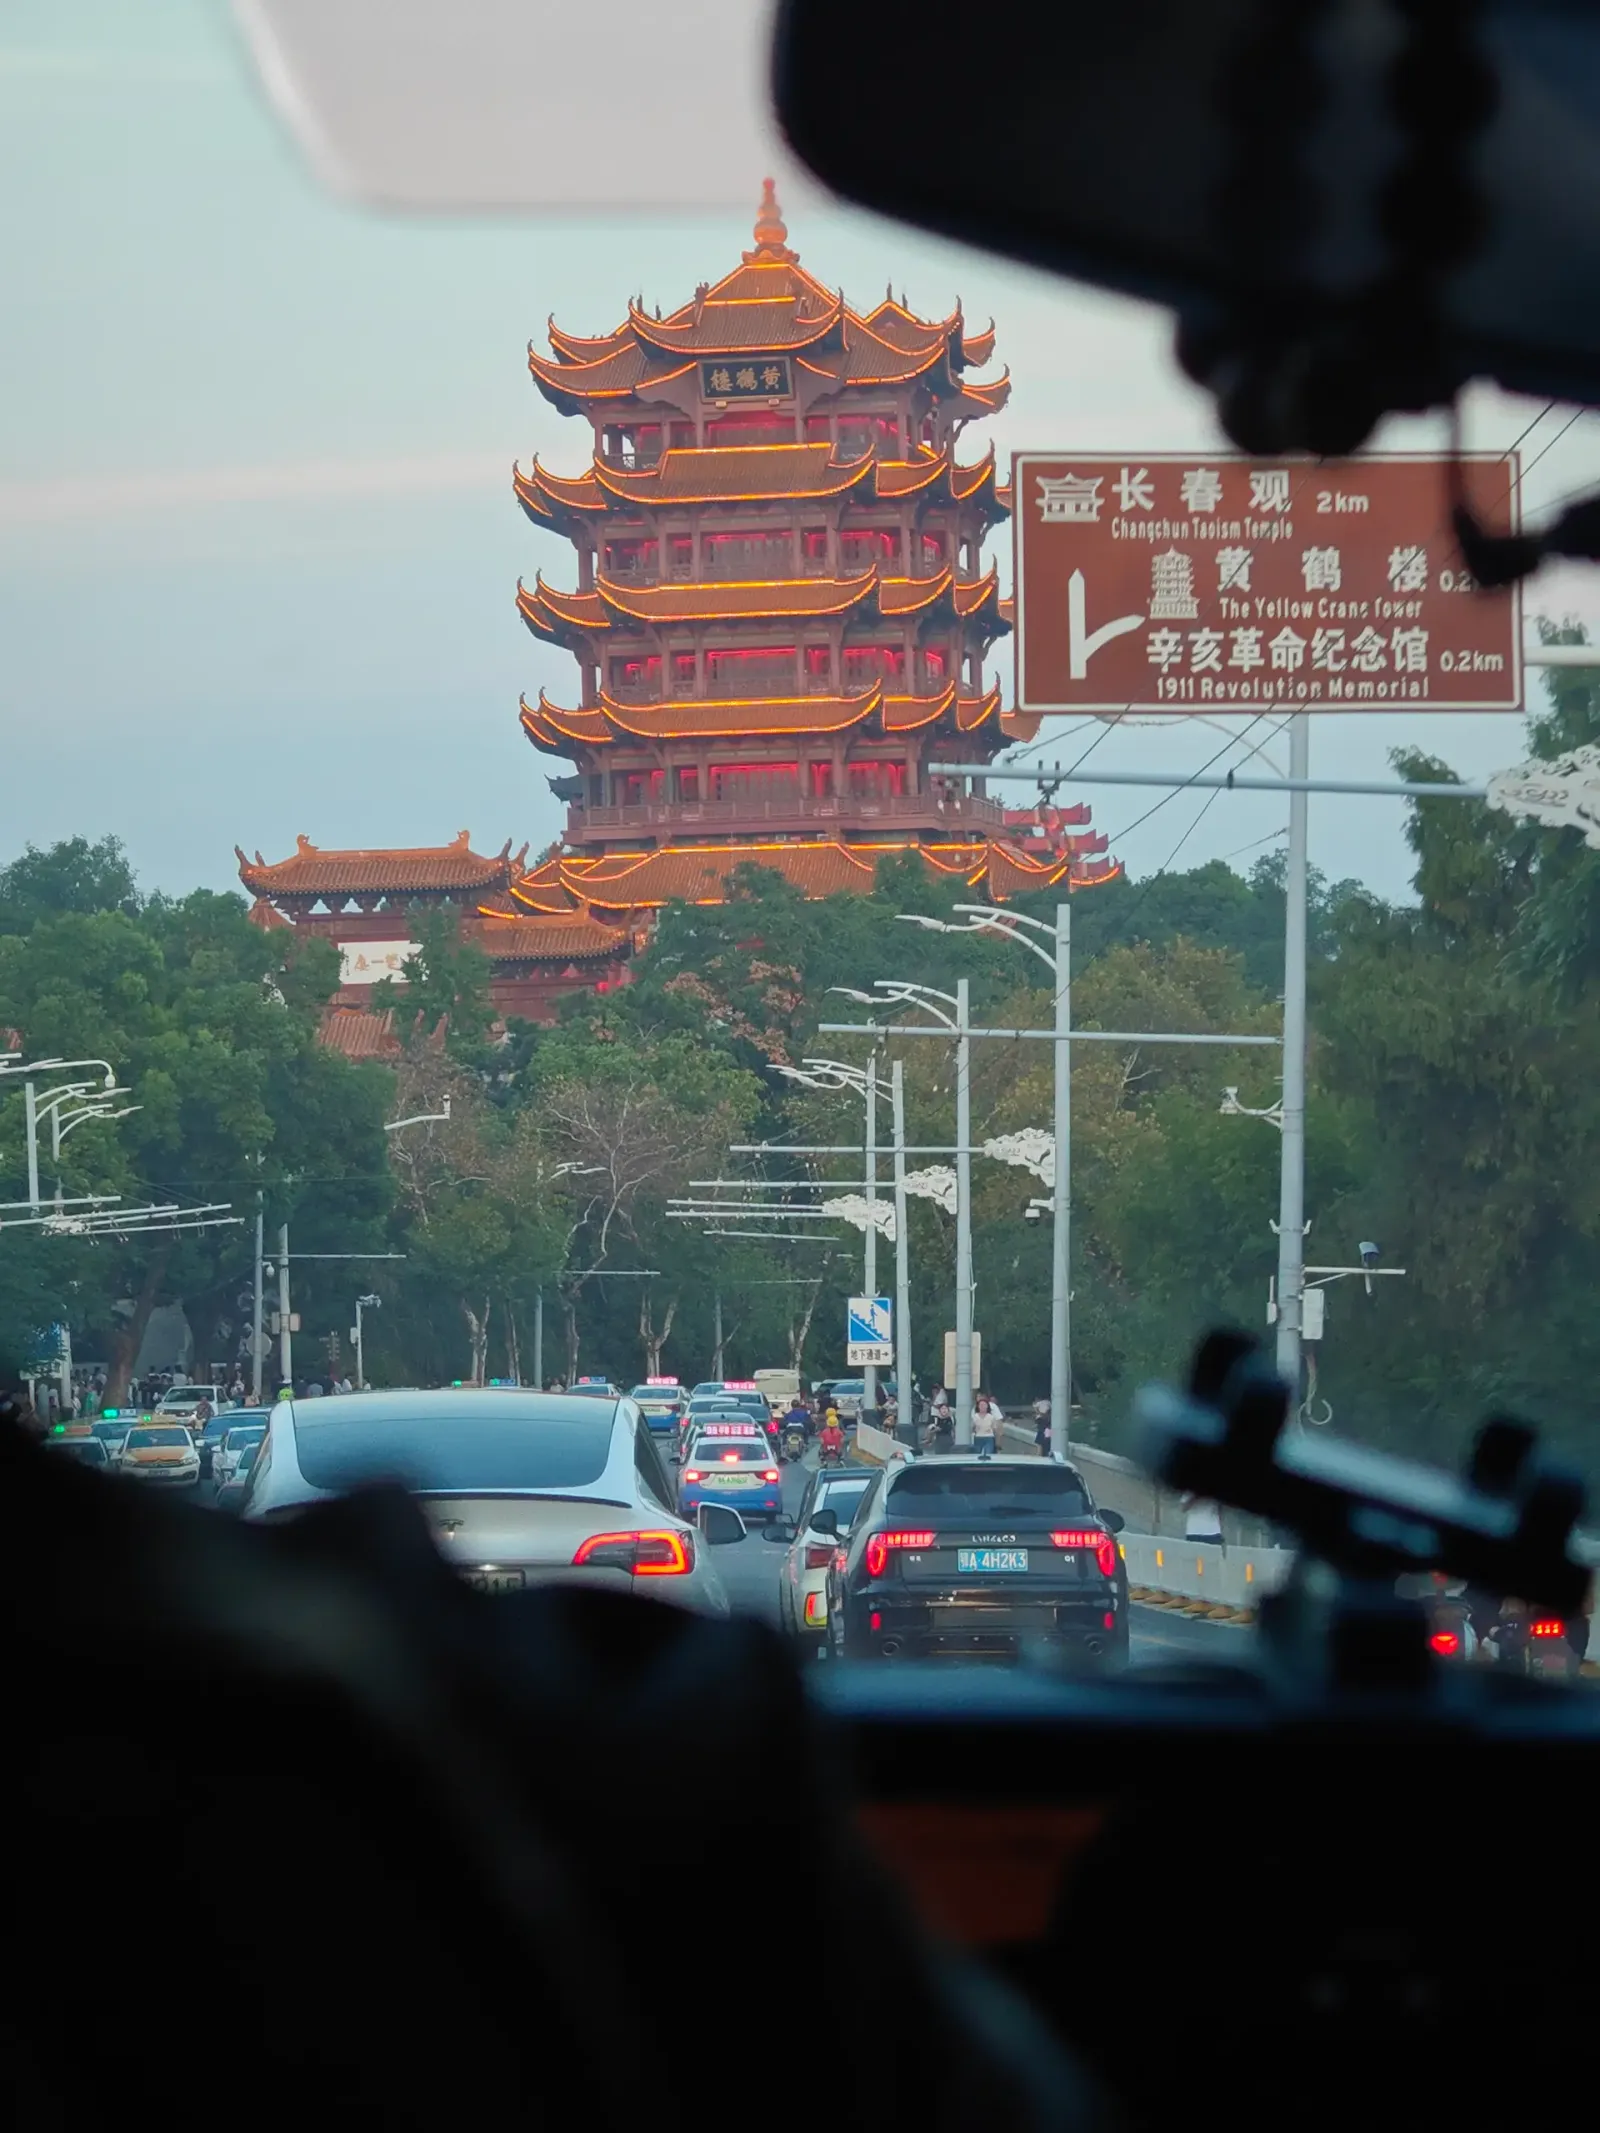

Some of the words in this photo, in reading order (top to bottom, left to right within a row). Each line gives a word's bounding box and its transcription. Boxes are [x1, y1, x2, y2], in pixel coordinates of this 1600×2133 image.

[1111, 467, 1293, 514] 长春观
[1111, 516, 1189, 543] Changchun
[1192, 516, 1241, 540] Taoism
[1244, 516, 1293, 543] Temple
[1215, 545, 1429, 592] 黄鹤楼
[1219, 597, 1250, 618] The
[1254, 596, 1314, 618] Yellow
[1317, 596, 1368, 618] Crane
[1374, 597, 1423, 618] Tower
[1146, 626, 1430, 673] 辛亥革命纪念馆
[1440, 649, 1504, 672] 0.2km
[1157, 676, 1194, 699] 1911
[1201, 676, 1322, 699] Revolution
[1329, 676, 1429, 699] Memorial
